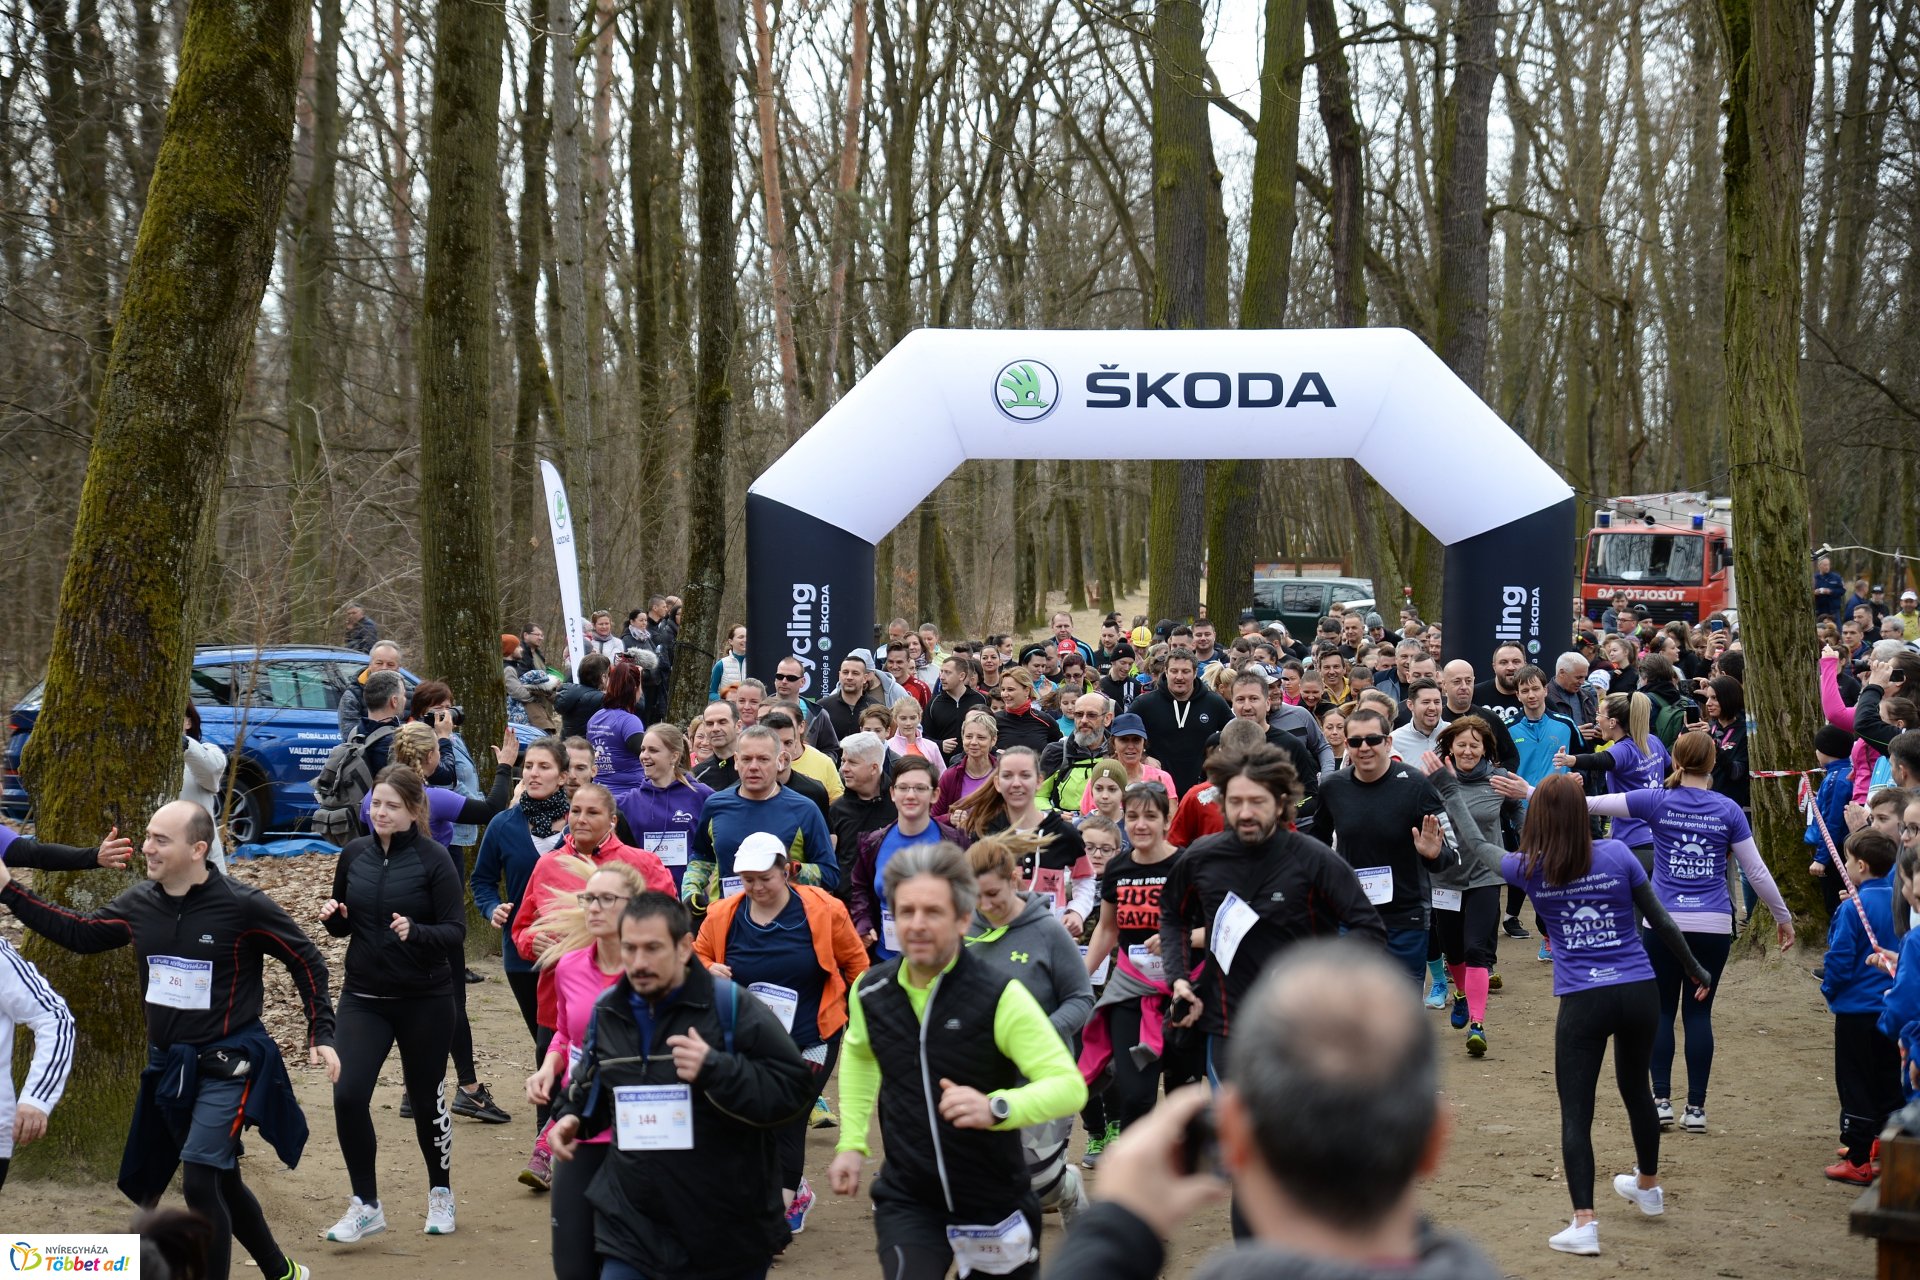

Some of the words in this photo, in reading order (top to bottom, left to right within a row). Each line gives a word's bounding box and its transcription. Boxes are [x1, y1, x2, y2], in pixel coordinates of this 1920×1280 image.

[1086, 364, 1337, 409] ŠKODA
[819, 584, 830, 633] ŠKODA
[1529, 586, 1540, 636] ŠKODA
[297, 732, 329, 740] PRÓBÁLJA
[288, 747, 317, 755] VALENT
[317, 748, 334, 756] AUT
[1684, 821, 1708, 830] sportoló
[1132, 877, 1145, 886] MY
[1433, 889, 1445, 898] 187
[1565, 884, 1594, 895] sportoló
[1118, 888, 1161, 907] JUS
[153, 957, 170, 965] SPURI
[169, 959, 209, 970] NYÍREGYHÁZA
[168, 976, 183, 987] 261
[639, 1113, 657, 1125] 144
[432, 1080, 453, 1170] adidas
